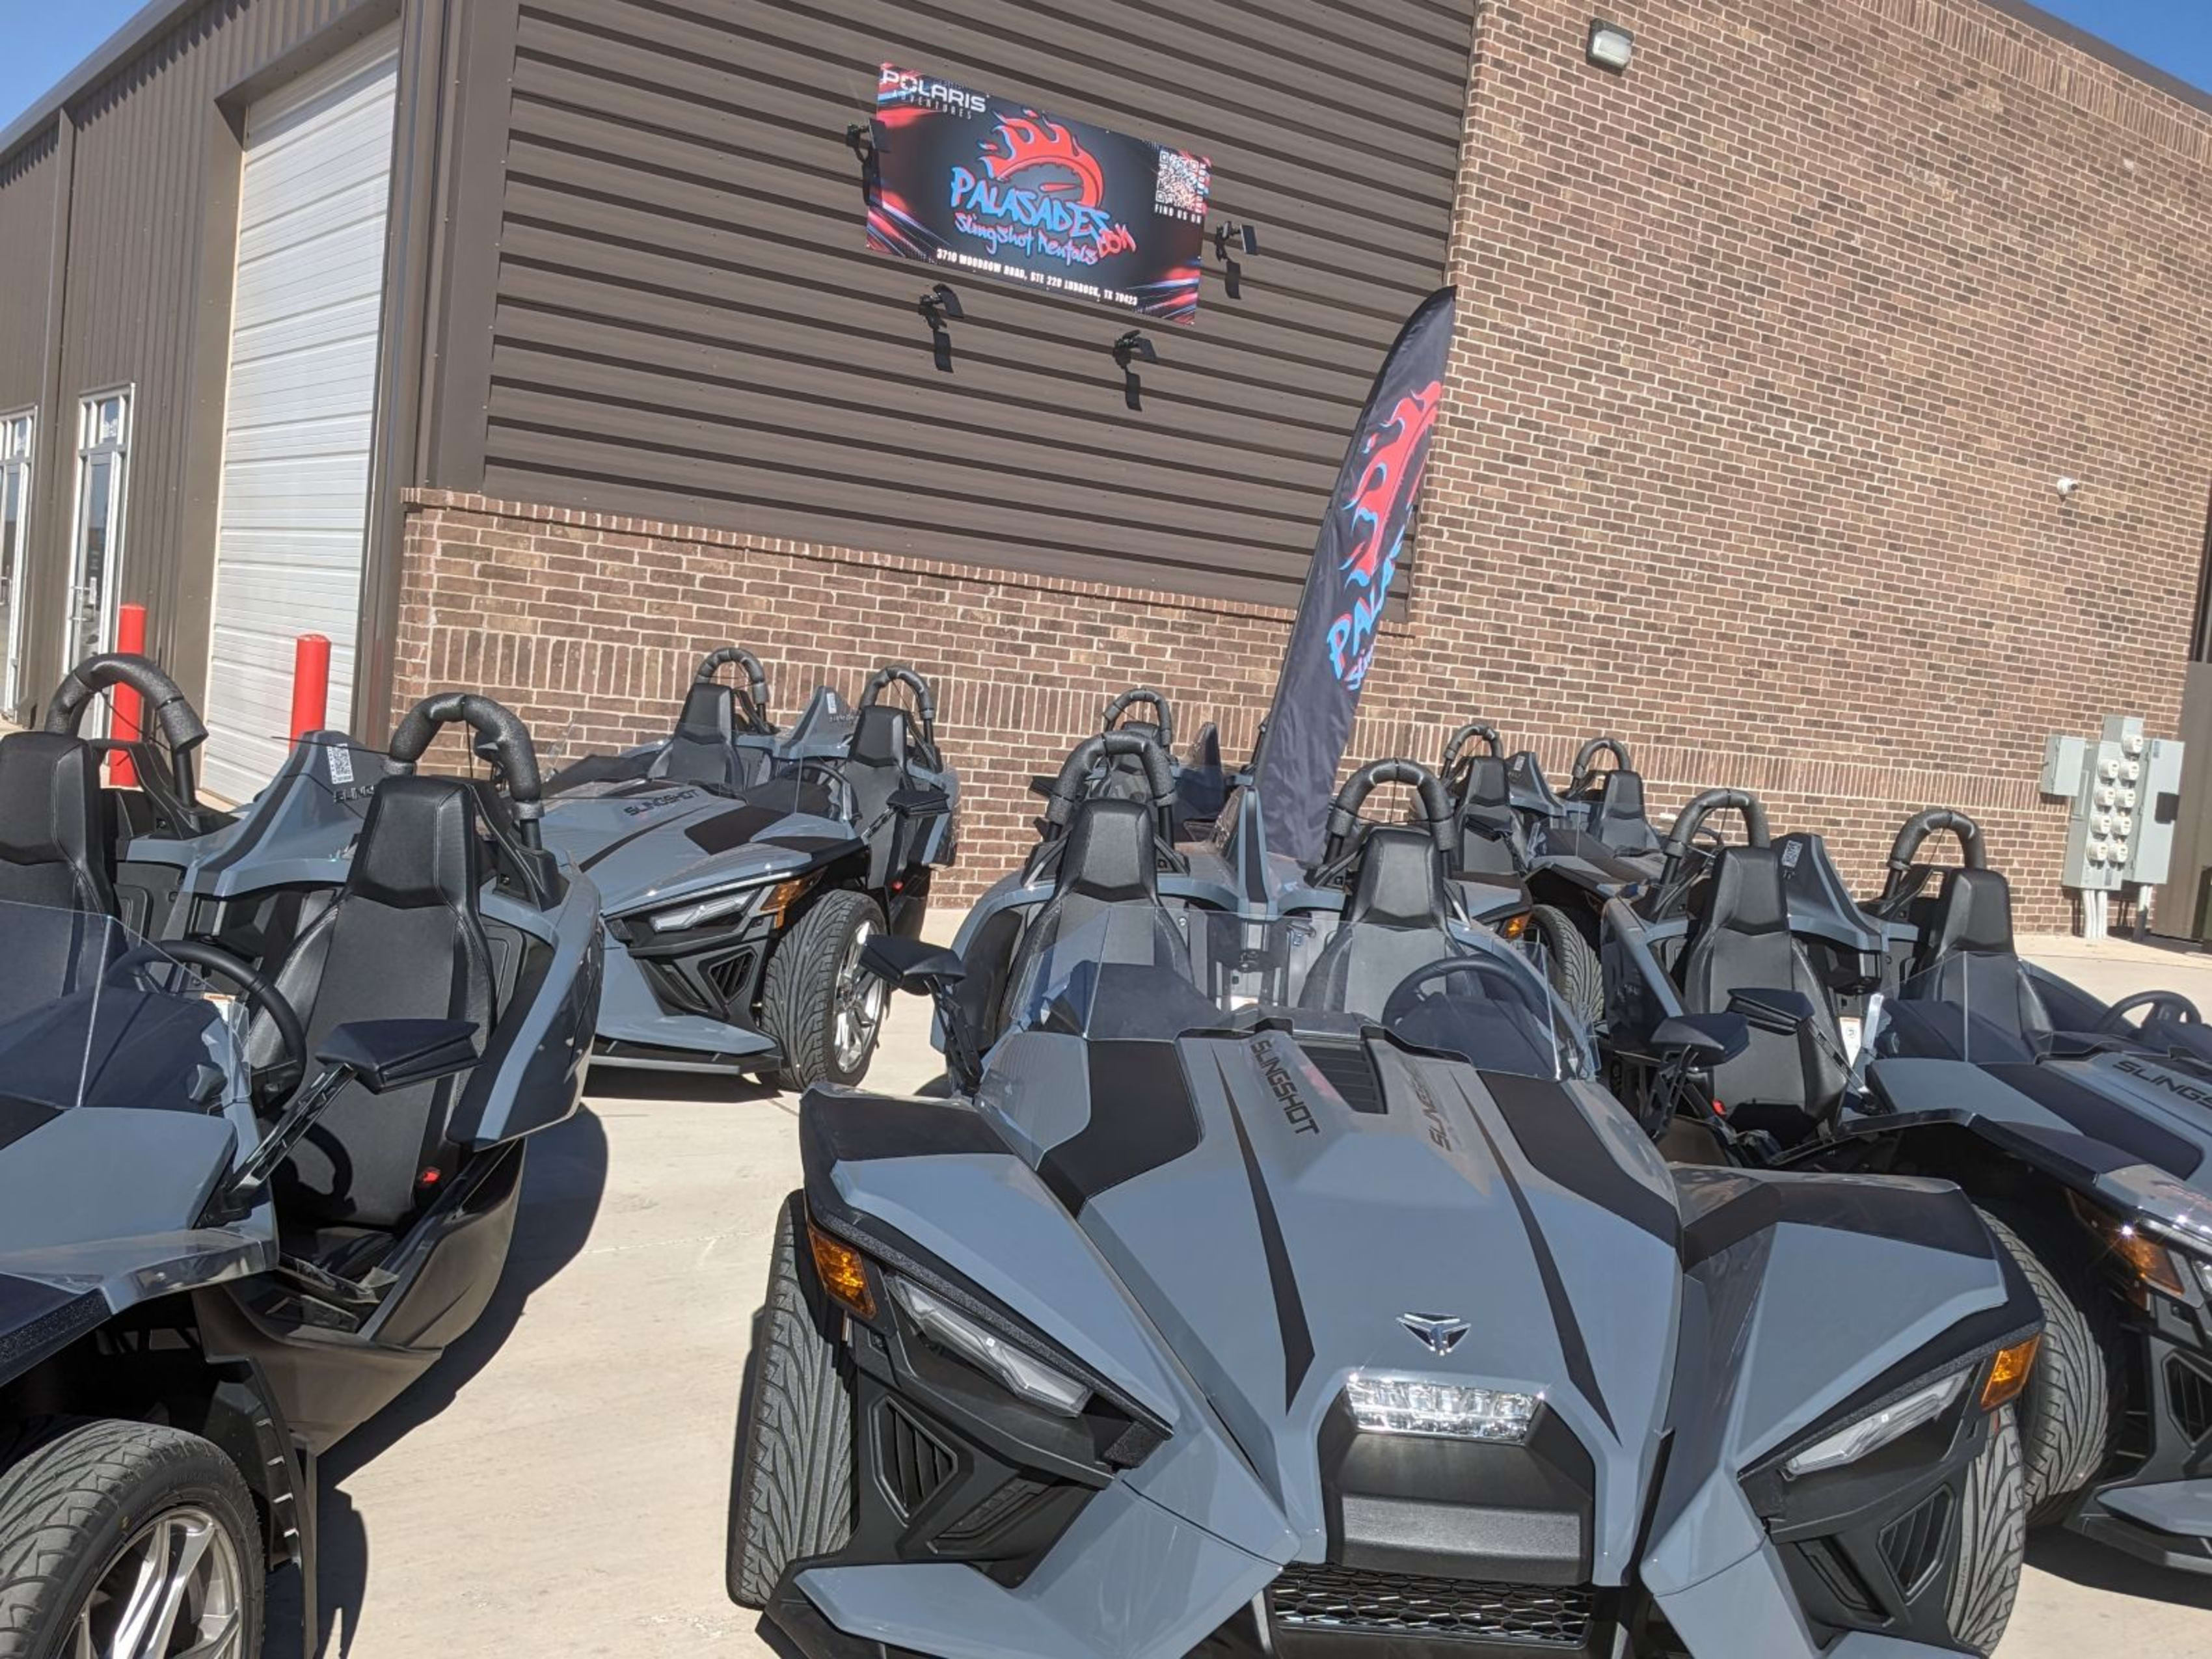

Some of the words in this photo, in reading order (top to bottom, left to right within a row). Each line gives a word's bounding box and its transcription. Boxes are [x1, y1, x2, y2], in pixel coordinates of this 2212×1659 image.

[879, 68, 986, 113] POLARIS
[951, 167, 1110, 239] PALASADES
[1155, 203, 1174, 217] FIND
[1177, 209, 1187, 221] US
[1191, 213, 1202, 224] ON
[958, 254, 1002, 273] WOODROW
[1031, 271, 1045, 284] STE
[1104, 289, 1114, 301] TX
[623, 789, 700, 816] SLINGSHOT
[1249, 1040, 1320, 1136] SLINGSHOT
